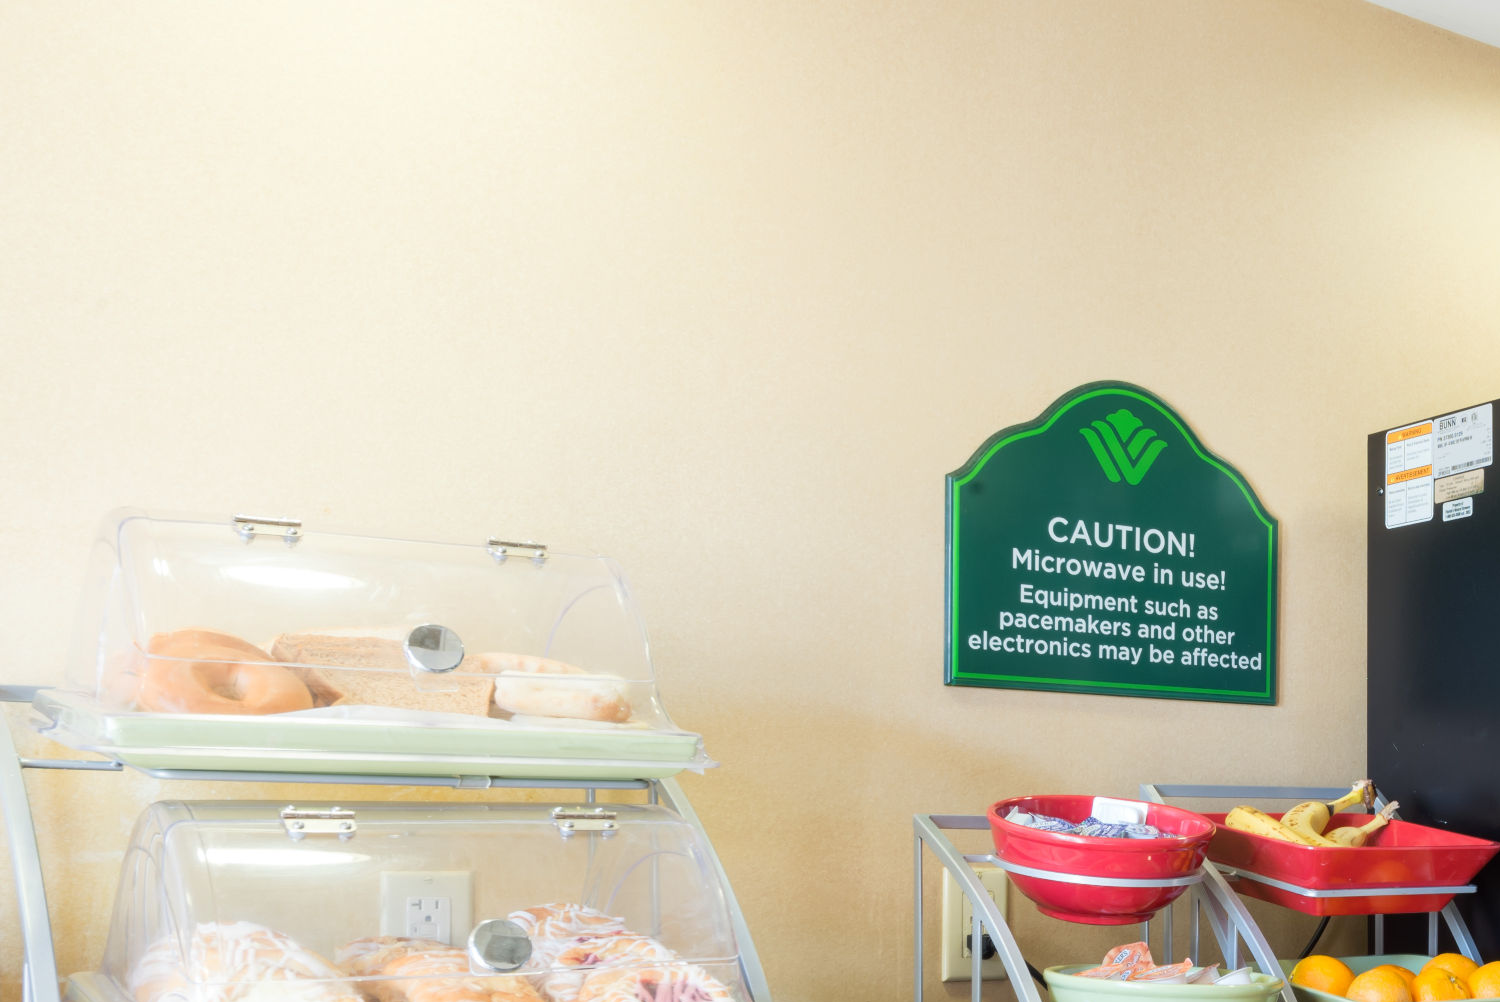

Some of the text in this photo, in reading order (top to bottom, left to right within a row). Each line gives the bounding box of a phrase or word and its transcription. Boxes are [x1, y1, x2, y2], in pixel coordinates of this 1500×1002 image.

[1440, 418, 1457, 430] BUNN
[1048, 517, 1195, 557] CAUTION!
[1012, 548, 1226, 590] Microwave in use!
[1020, 584, 1218, 620] Equipment such as
[999, 611, 1235, 645] pacemakers and other
[968, 631, 1262, 671] electronics may be affected
